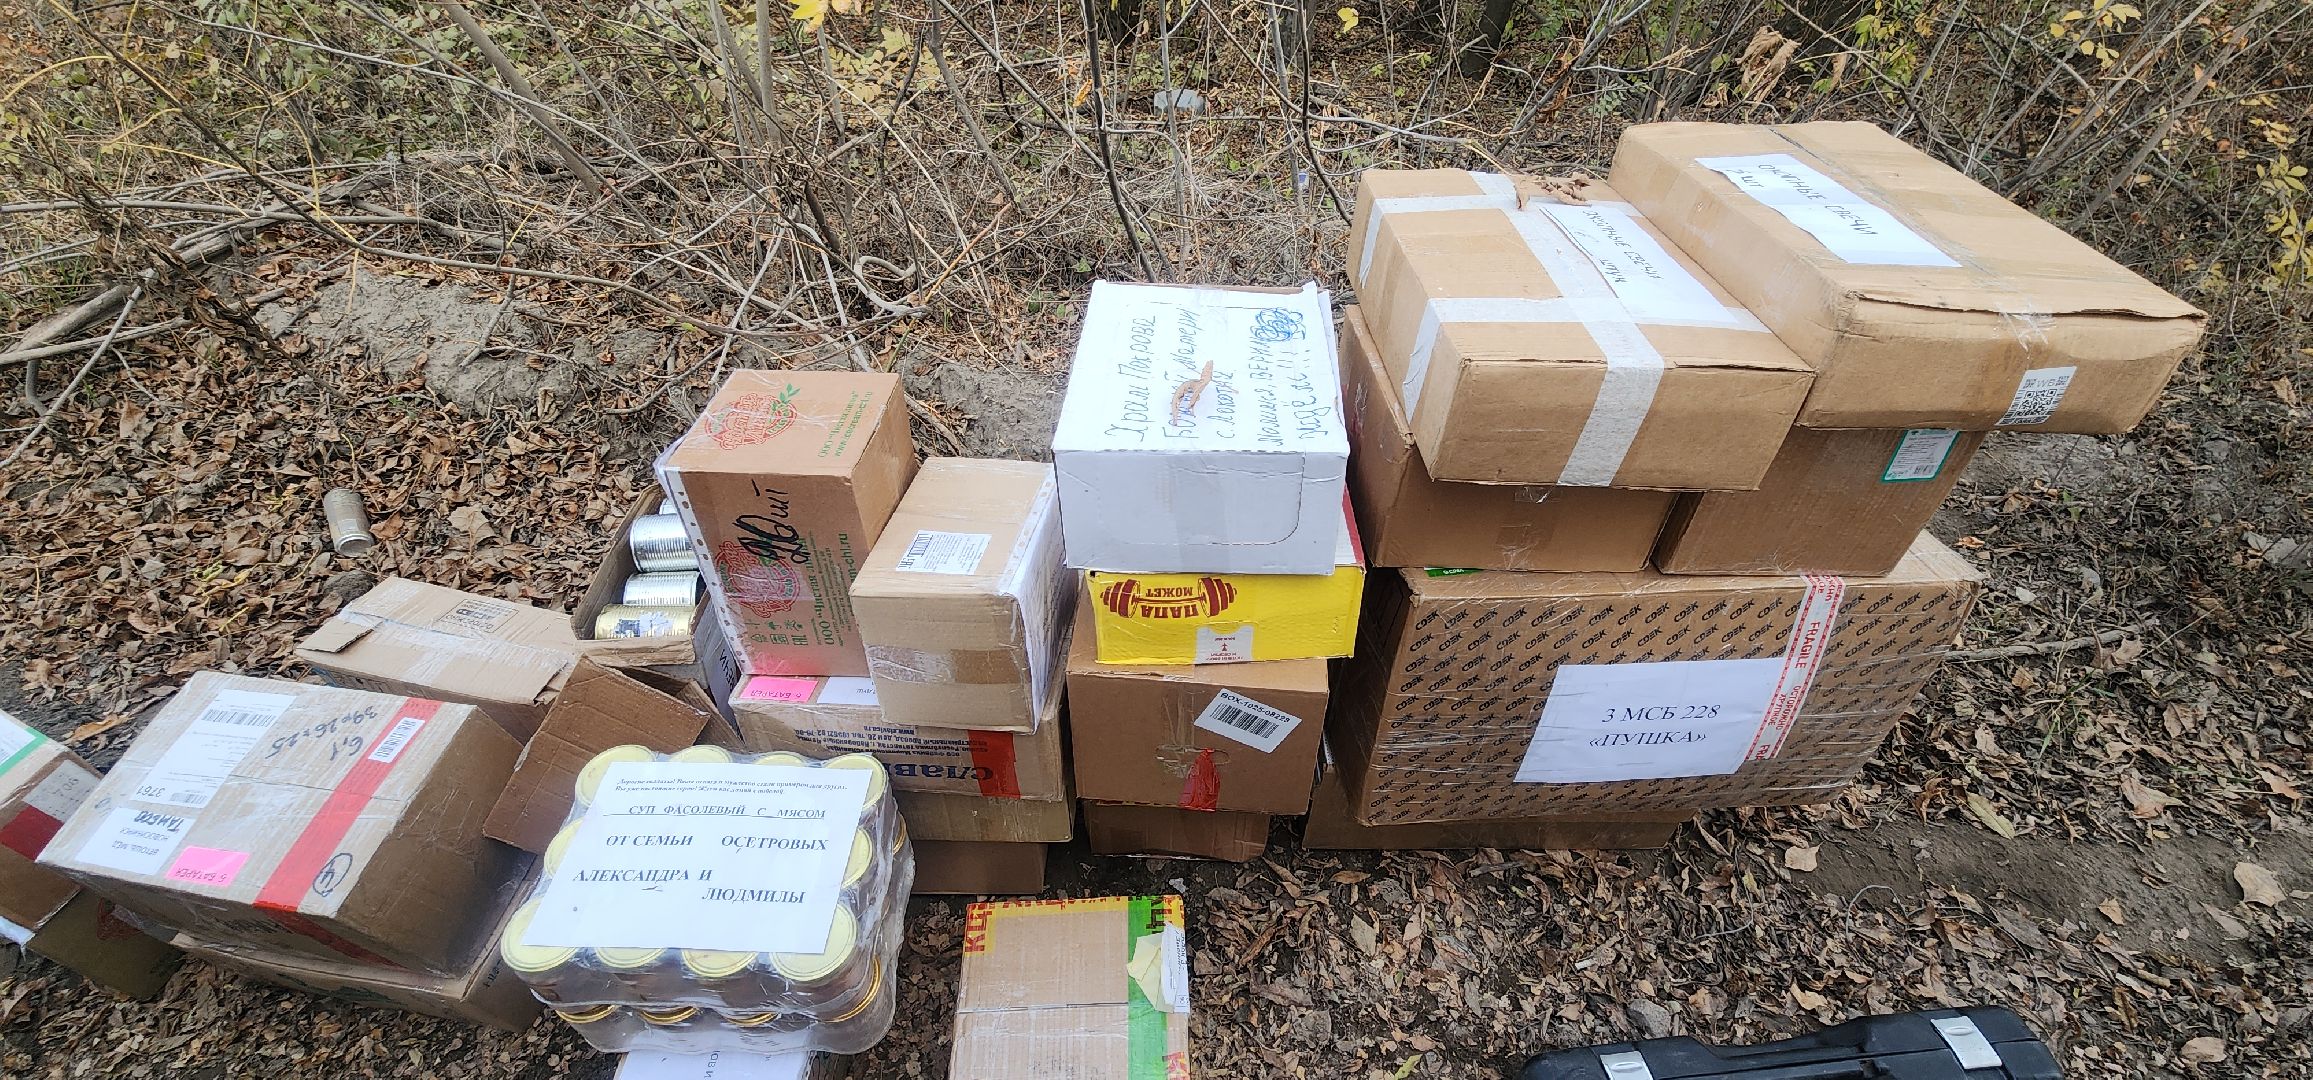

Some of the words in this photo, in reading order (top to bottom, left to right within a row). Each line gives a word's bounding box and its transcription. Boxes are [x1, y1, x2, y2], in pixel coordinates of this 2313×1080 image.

[1146, 586, 1193, 598] МОЖЕТ
[1839, 594, 1864, 613] CDEK
[1866, 593, 1892, 612] CDEK
[1894, 592, 1920, 611] CDEK
[1921, 591, 1947, 610] CDEK
[1140, 605, 1199, 618] ПАПА
[1415, 610, 1439, 630] CDEK
[1444, 609, 1468, 628] CDEK
[1473, 608, 1498, 627] CDEK
[1502, 607, 1527, 627] CDEK
[1531, 606, 1555, 626] CDEK
[1560, 606, 1584, 625] CDEK
[1589, 605, 1613, 625] CDEK
[1644, 603, 1669, 622] CDEK
[1674, 601, 1699, 621] CDEK
[1701, 600, 1726, 620] CDEK
[1729, 599, 1754, 618] CDEK
[1757, 598, 1782, 617] CDEK
[819, 621, 834, 644] ООО
[1856, 616, 1881, 635] CDEK
[1883, 615, 1908, 634] CDEK
[1910, 614, 1935, 633] CDEK
[1410, 632, 1434, 651] CDEK
[1439, 631, 1463, 651] CDEK
[1467, 631, 1491, 650] CDEK
[1496, 630, 1520, 649] CDEK
[1525, 630, 1549, 649] CDEK
[1553, 629, 1578, 648] CDEK
[1582, 629, 1606, 648] CDEK
[1610, 629, 1634, 648] CDEK
[1637, 627, 1661, 646] CDEK
[1666, 625, 1690, 644] CDEK
[1693, 624, 1718, 643] CDEK
[1721, 623, 1746, 642] CDEK
[1748, 622, 1773, 641] CDEK
[1794, 621, 1820, 670] FRAGILE
[1845, 639, 1870, 657] CDEK
[1871, 637, 1896, 655] CDEK
[1897, 636, 1922, 654] CDEK
[1434, 653, 1457, 672] CDEK
[1462, 652, 1485, 671] CDEK
[1490, 652, 1514, 671] CDEK
[1518, 652, 1542, 671] CDEK
[1546, 652, 1570, 670] CDEK
[1428, 674, 1451, 692] CDEK
[1456, 673, 1480, 692] CDEK
[1484, 673, 1508, 692] CDEK
[1512, 673, 1536, 691] CDEK
[1220, 692, 1291, 724] BOX-1025-08229
[1423, 693, 1446, 711] CDEK
[1451, 693, 1474, 711] CDEK
[1478, 693, 1501, 711] CDEK
[1506, 693, 1529, 711] CDEK
[1766, 693, 1786, 727] ХРУПКОЕ
[1776, 685, 1801, 731] ОСТОРОЖНО
[1602, 706, 1615, 723] 3
[1620, 705, 1674, 722] МСБ
[1681, 704, 1721, 721] 228
[1588, 729, 1708, 748] «ПУШКА»
[136, 786, 165, 797] 3761
[629, 804, 655, 815] СУП
[664, 803, 746, 815] ФАСОЛЕВЫЙ
[757, 807, 767, 816] С
[777, 808, 825, 818] МЯСОМ
[606, 836, 628, 847] ОТ
[632, 835, 693, 846] СЕМЬИ
[721, 835, 829, 850] ОСЕТРОВЫХ
[573, 869, 689, 882] АЛЕКСАНДРА
[698, 869, 712, 881] И
[701, 887, 805, 904] ЛЮДМИЛЫ
